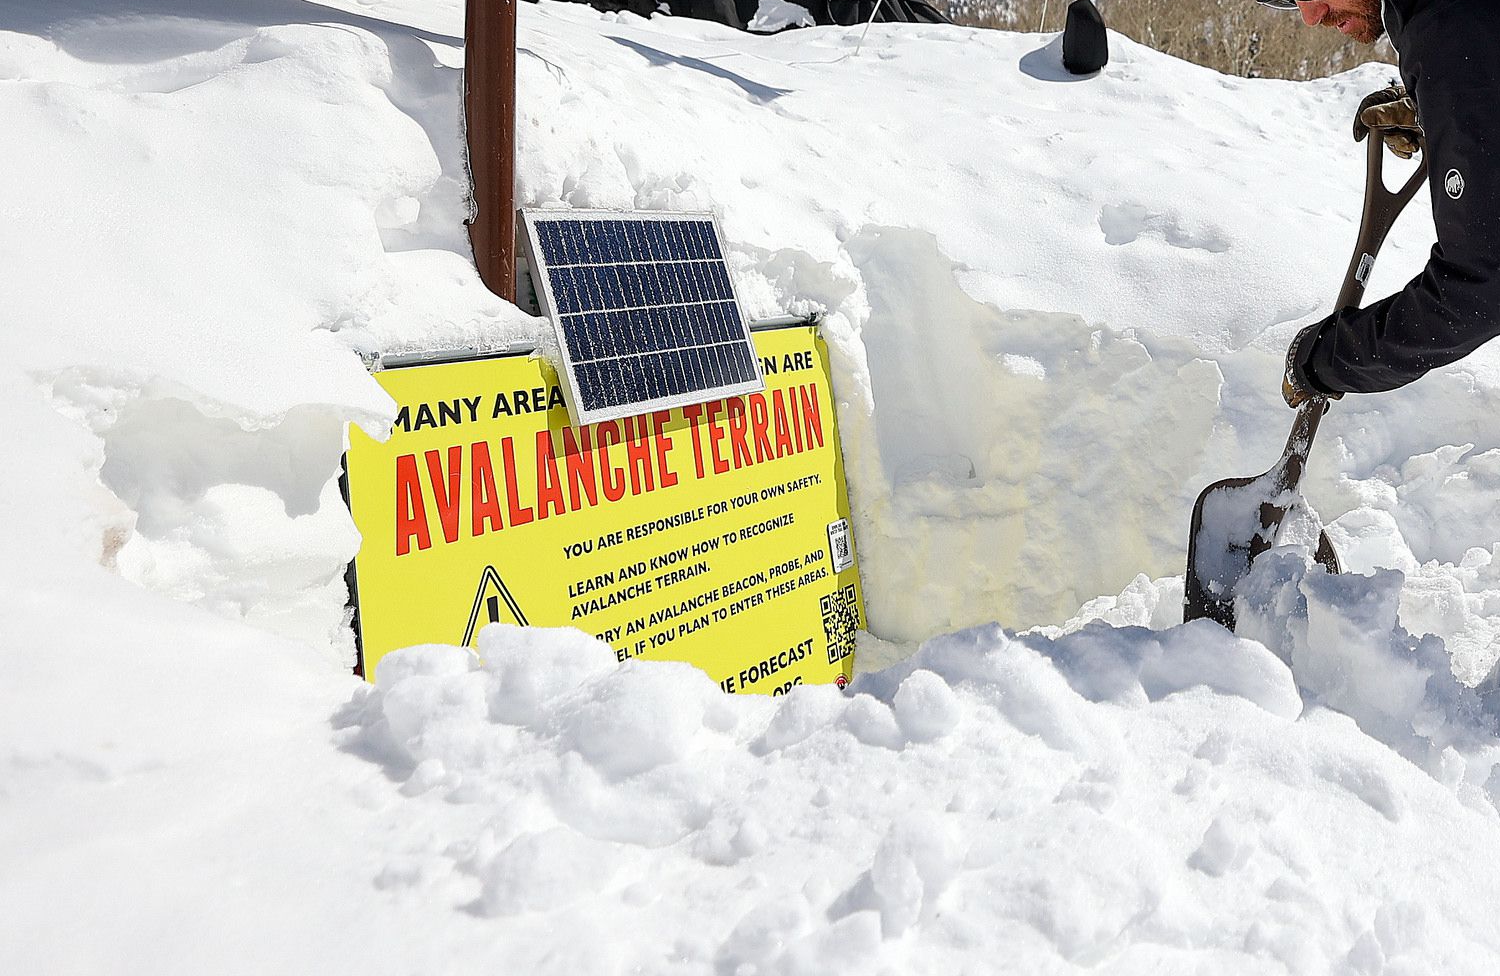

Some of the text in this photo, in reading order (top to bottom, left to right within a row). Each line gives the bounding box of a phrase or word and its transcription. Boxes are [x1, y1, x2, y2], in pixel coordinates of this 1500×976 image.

[492, 385, 566, 419] AREA
[783, 351, 812, 372] ARE
[396, 384, 823, 556] AVALANCHE TERRAIN
[564, 473, 821, 559] YOU ARE RESPONSIBLE FOR YOUR OWN SAFETY.
[569, 513, 794, 598] LEARN AND KNOW HOW TO RECOGNIZE
[572, 561, 710, 620] AVALANCHE TERRAIN.
[627, 618, 644, 635] AN
[649, 589, 719, 626] AVALANCHE
[722, 572, 767, 597] BEACON,
[770, 559, 802, 579] PROBE,
[805, 550, 823, 565] AND
[635, 567, 829, 655] IF YOU PLAN TO ENTER THESE AREAS.
[740, 639, 813, 688] FORECAST
